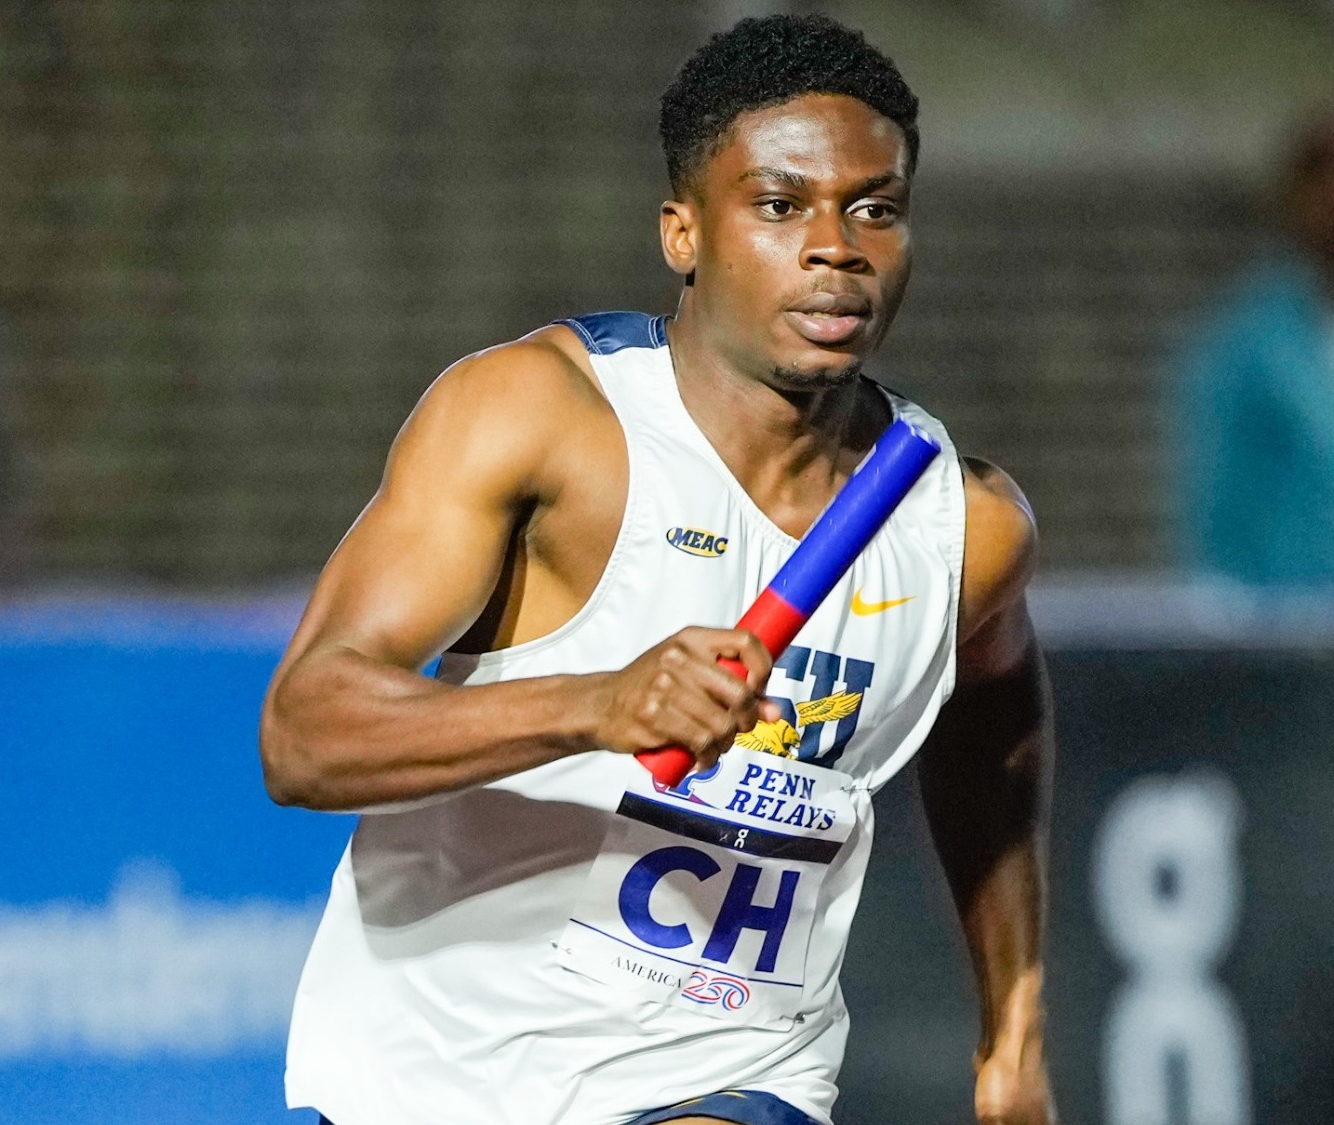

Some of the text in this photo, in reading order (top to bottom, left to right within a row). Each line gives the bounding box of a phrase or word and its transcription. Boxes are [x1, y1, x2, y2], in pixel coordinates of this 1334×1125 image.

[670, 527, 729, 555] MEAC
[739, 763, 816, 800] PENN
[725, 789, 836, 831] RELAYS
[619, 846, 801, 973] CH
[611, 956, 751, 1011] AMERICA 250
